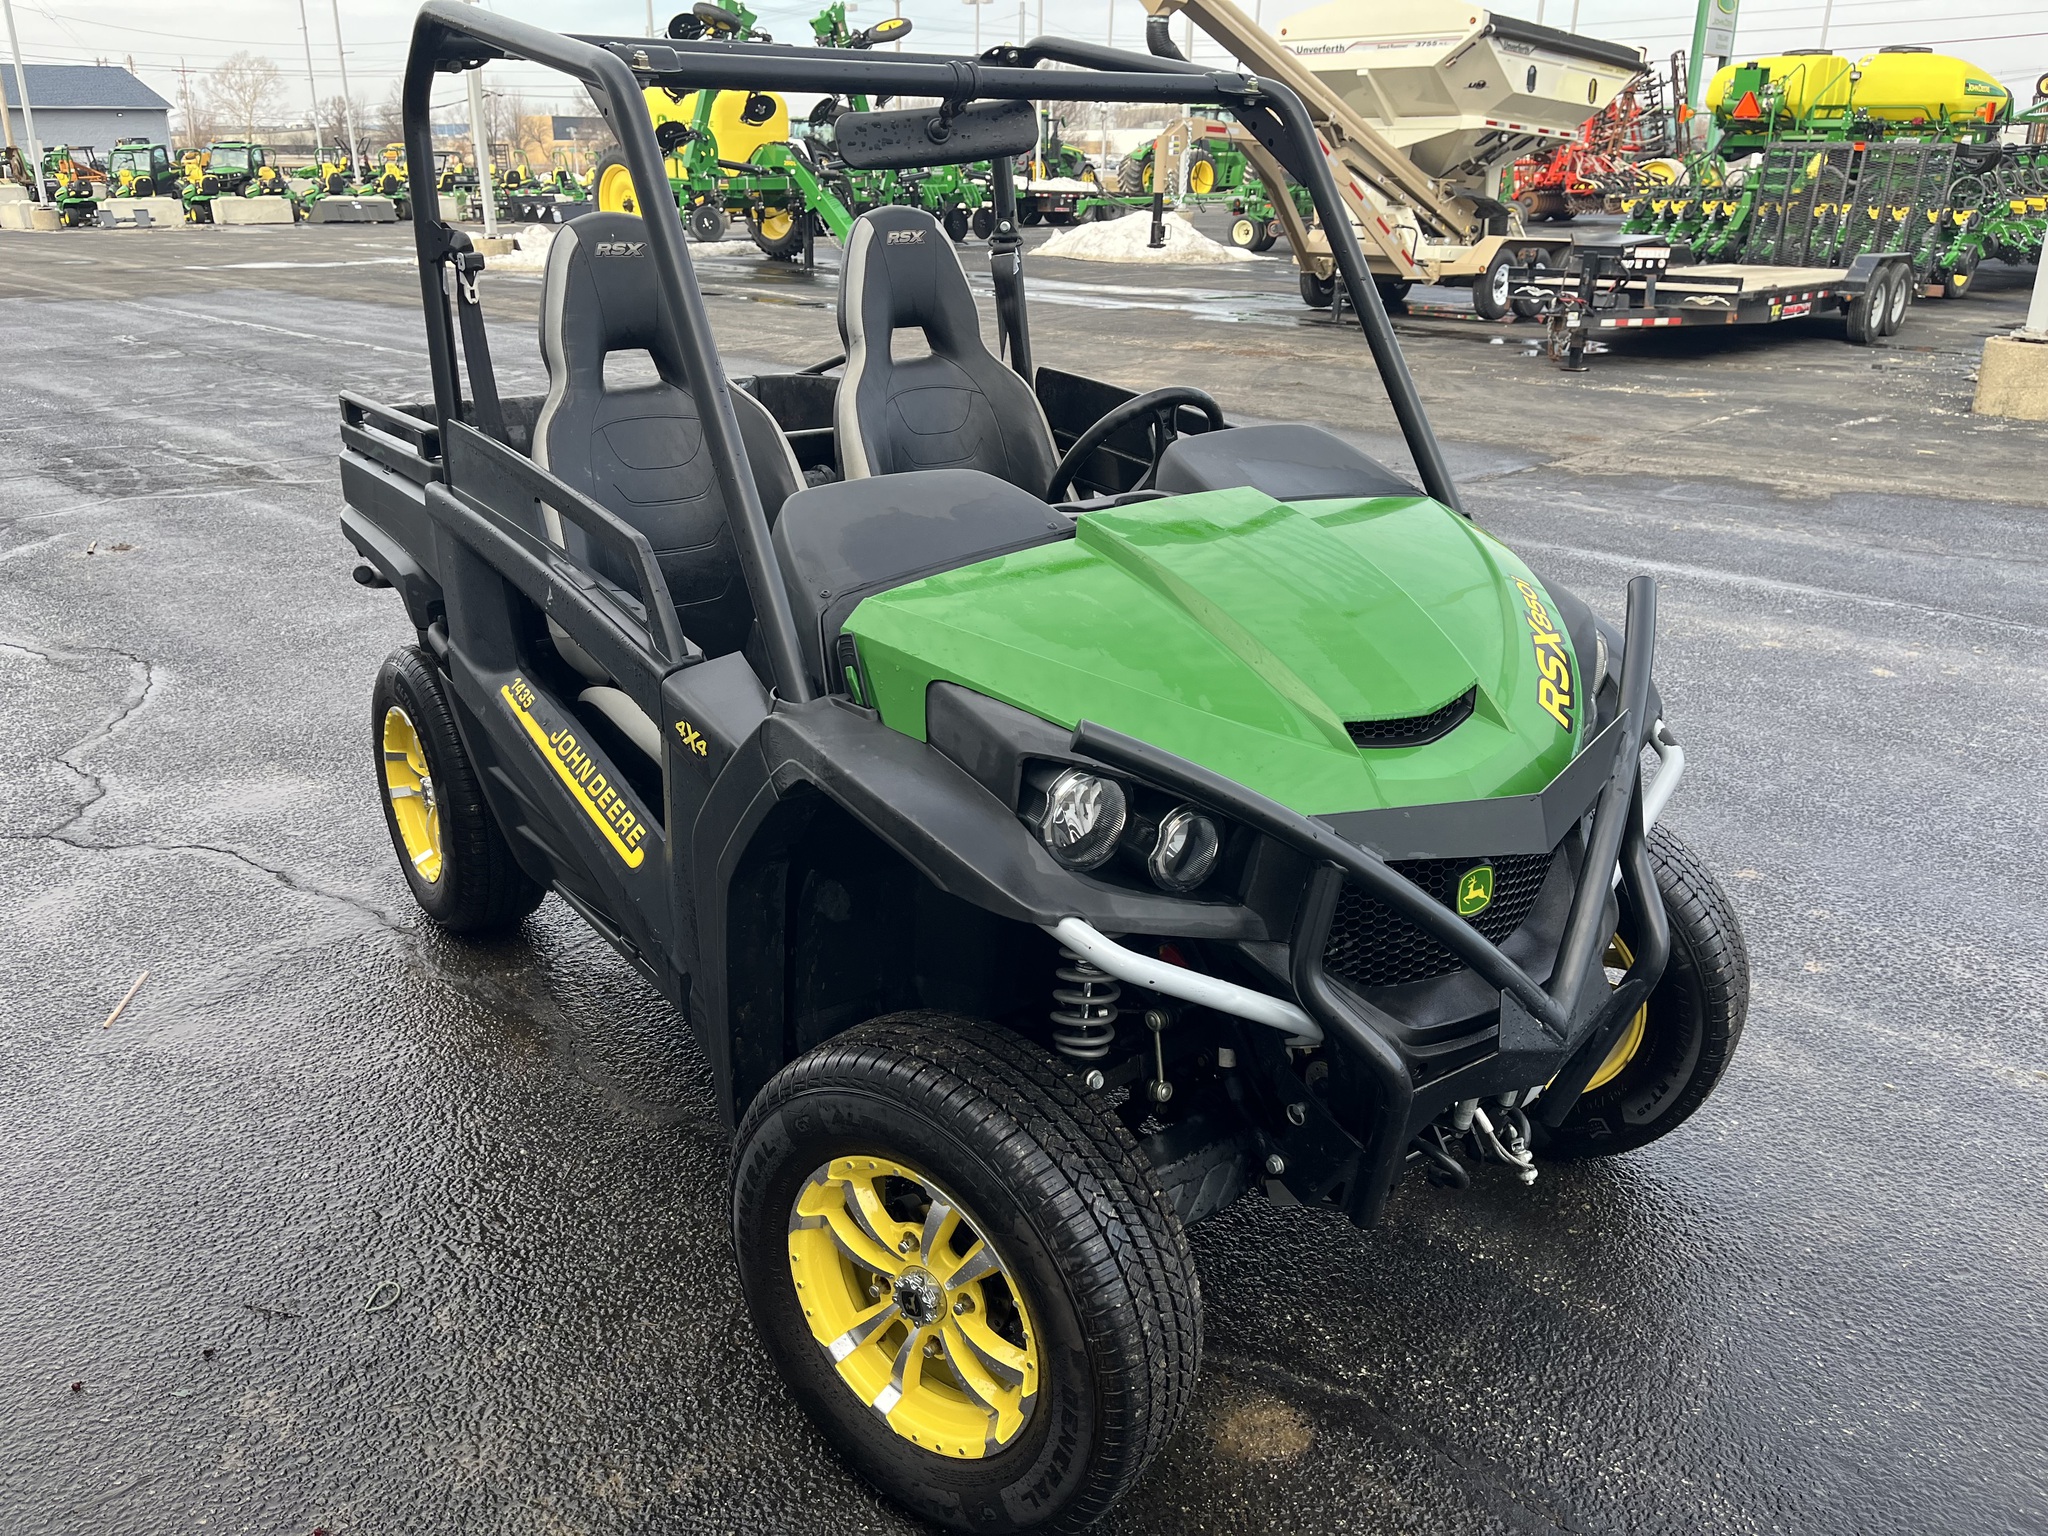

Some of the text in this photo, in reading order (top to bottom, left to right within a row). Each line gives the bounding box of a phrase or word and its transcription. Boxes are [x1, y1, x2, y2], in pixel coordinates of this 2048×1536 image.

[1296, 44, 1345, 54] Unverferth
[886, 229, 927, 246] RSX
[594, 241, 649, 258] RSX
[509, 677, 536, 709] 1435
[550, 728, 647, 848] JOHN DEERE
